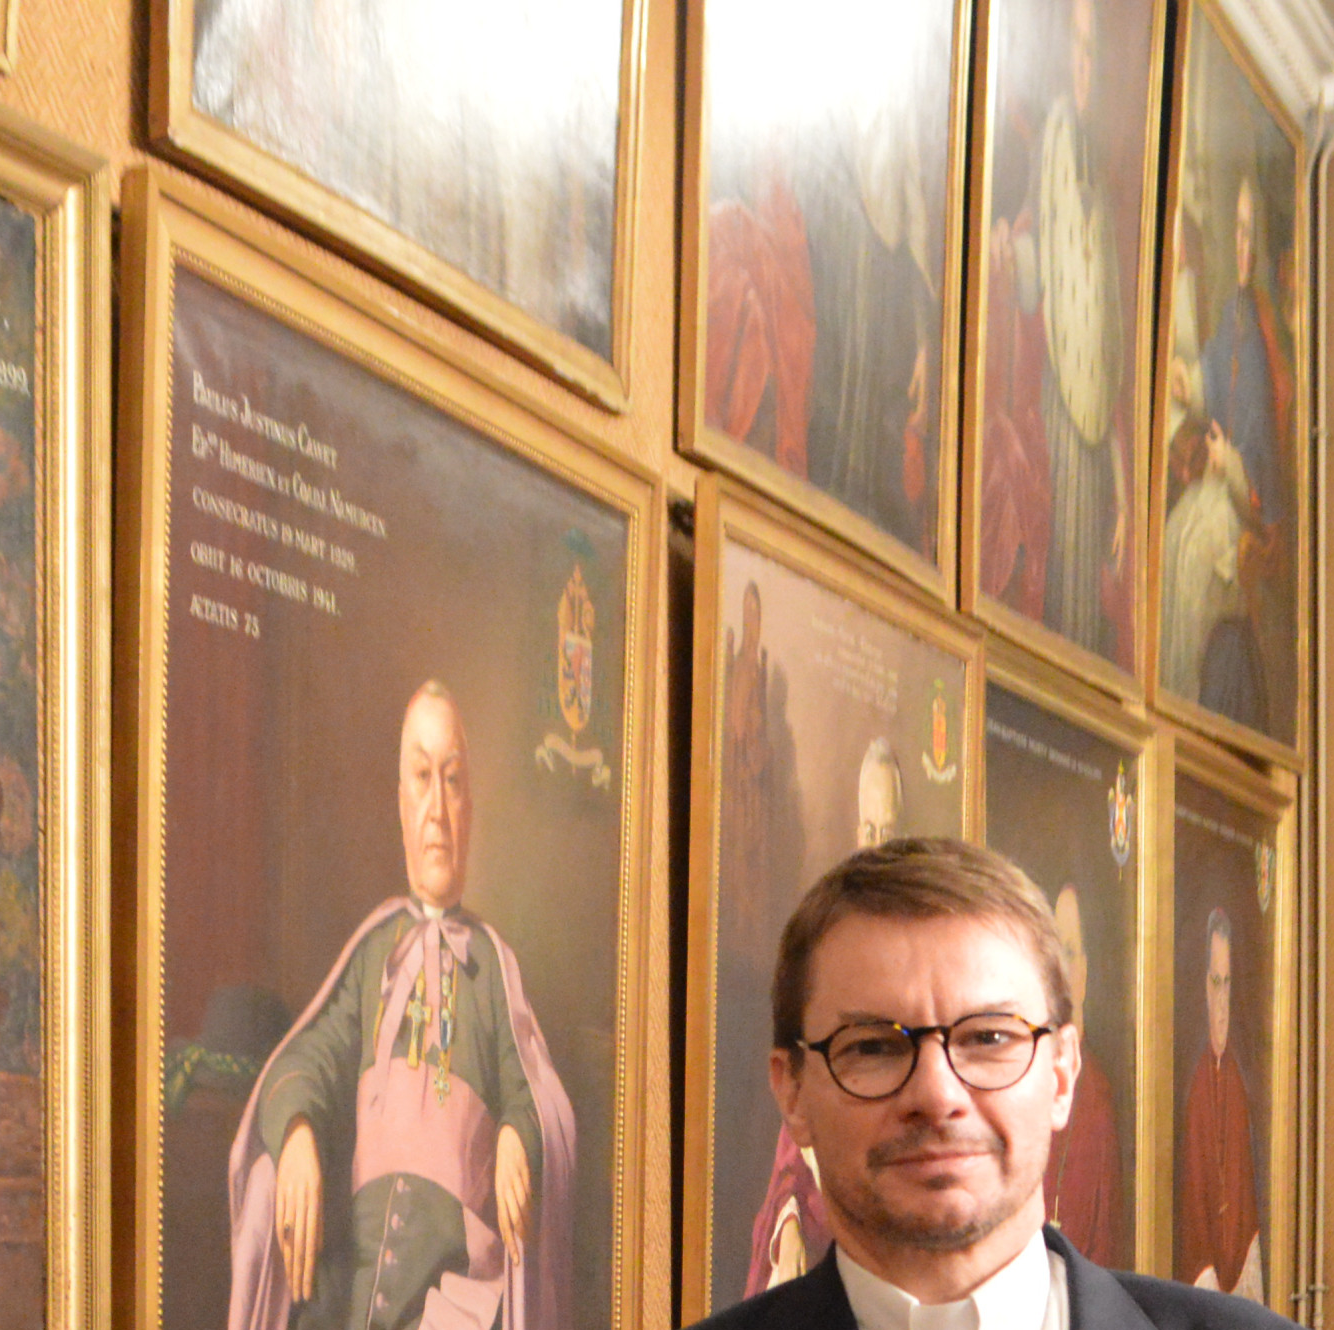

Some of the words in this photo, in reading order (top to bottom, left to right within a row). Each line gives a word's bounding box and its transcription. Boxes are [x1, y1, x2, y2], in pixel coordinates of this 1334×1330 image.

[193, 486, 278, 541] CONSECRATUS
[190, 540, 226, 573] OBIIT
[248, 562, 308, 602] OCTOBRIS
